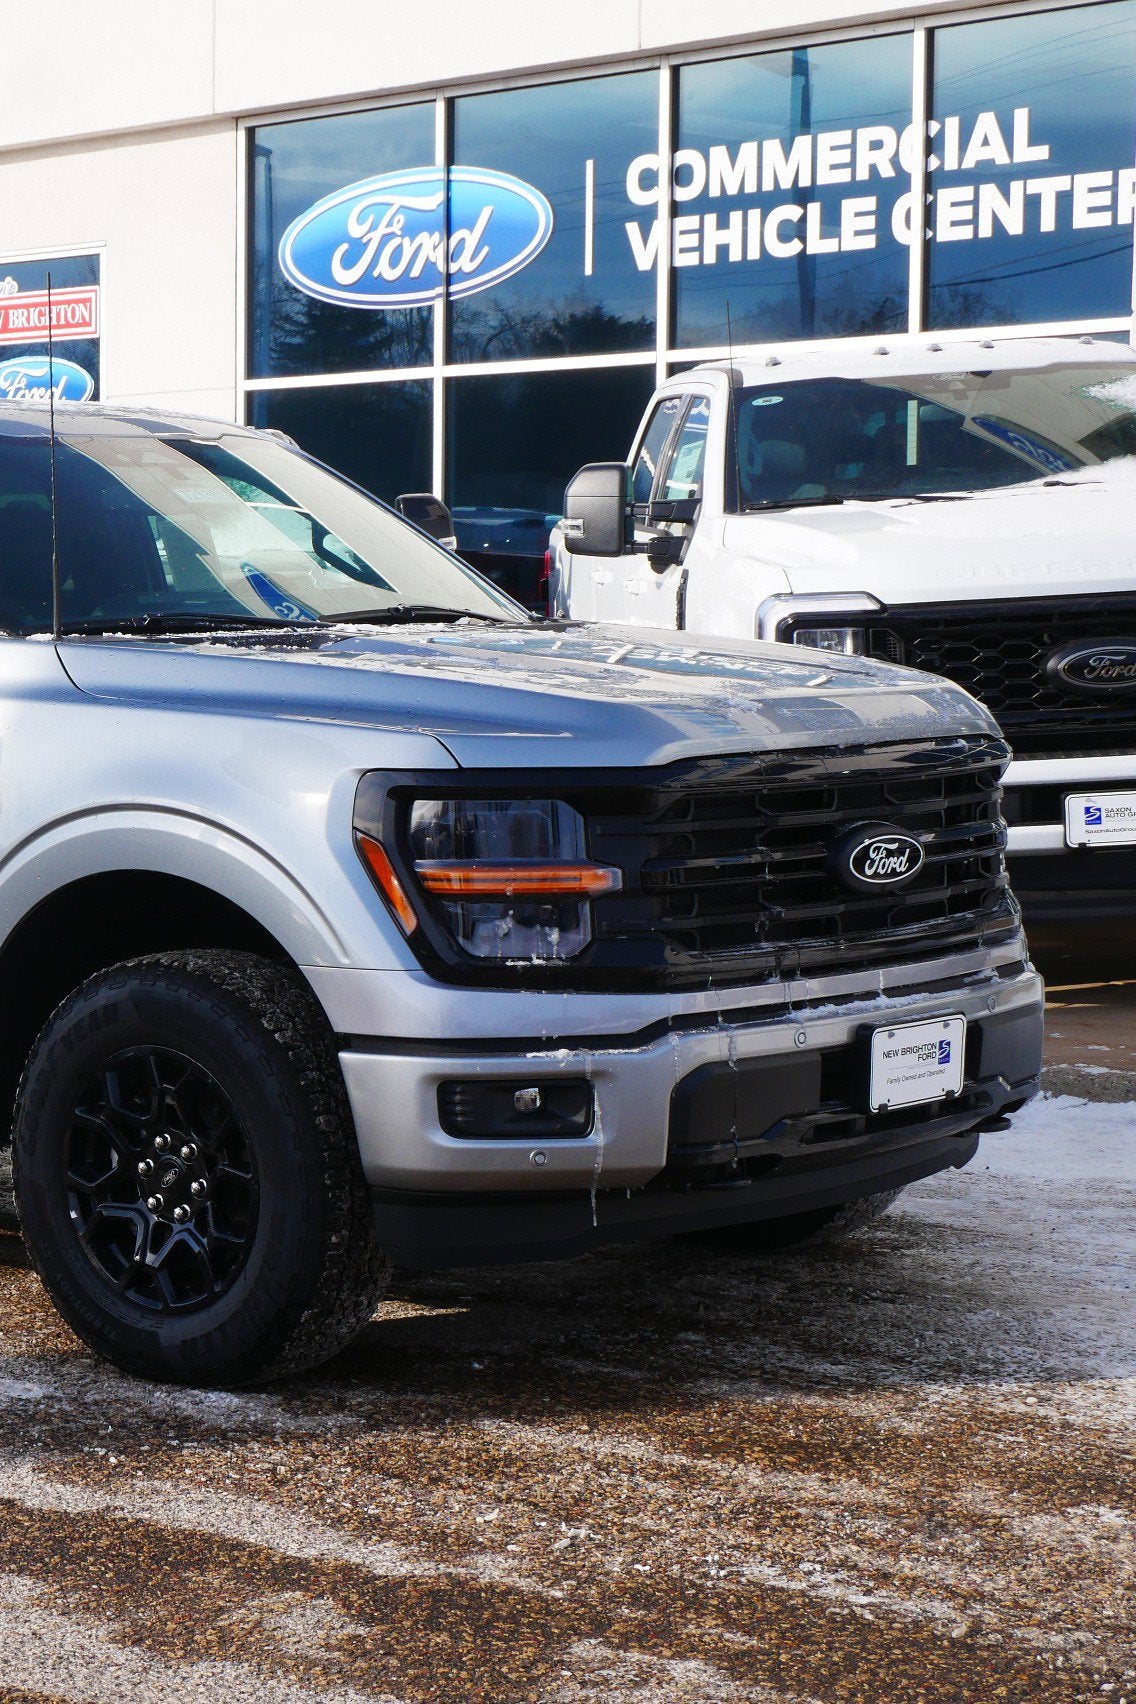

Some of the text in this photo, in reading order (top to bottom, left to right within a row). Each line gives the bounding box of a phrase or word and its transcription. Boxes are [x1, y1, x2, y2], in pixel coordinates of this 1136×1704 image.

[626, 108, 1050, 206] COMMERCIAL
[331, 190, 494, 286] Ford
[626, 196, 877, 272] VEHICLE
[7, 302, 91, 329] BRIGHTON
[865, 842, 910, 876] Ford
[882, 1042, 937, 1060] NEW BRIGHTON
[918, 1051, 937, 1062] FORD
